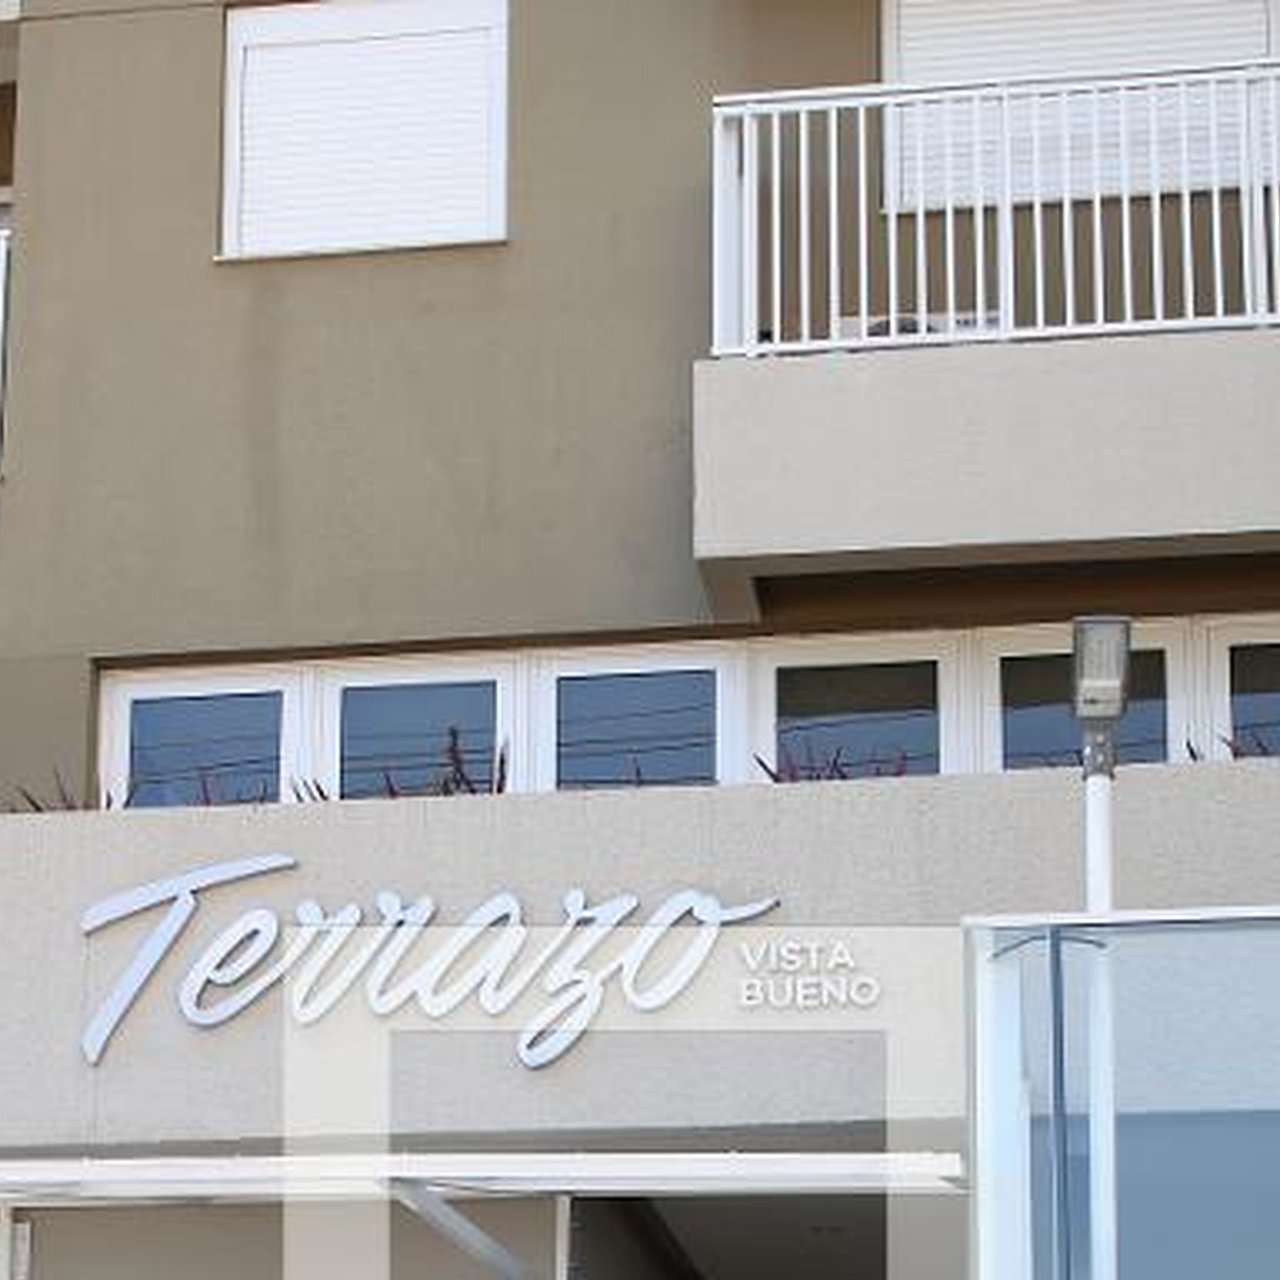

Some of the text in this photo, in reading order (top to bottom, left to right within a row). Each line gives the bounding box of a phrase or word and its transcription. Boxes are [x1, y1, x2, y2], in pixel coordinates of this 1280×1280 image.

[81, 852, 782, 1070] Terrazo
[741, 940, 858, 971] VISTA
[742, 974, 882, 1009] BUENO
